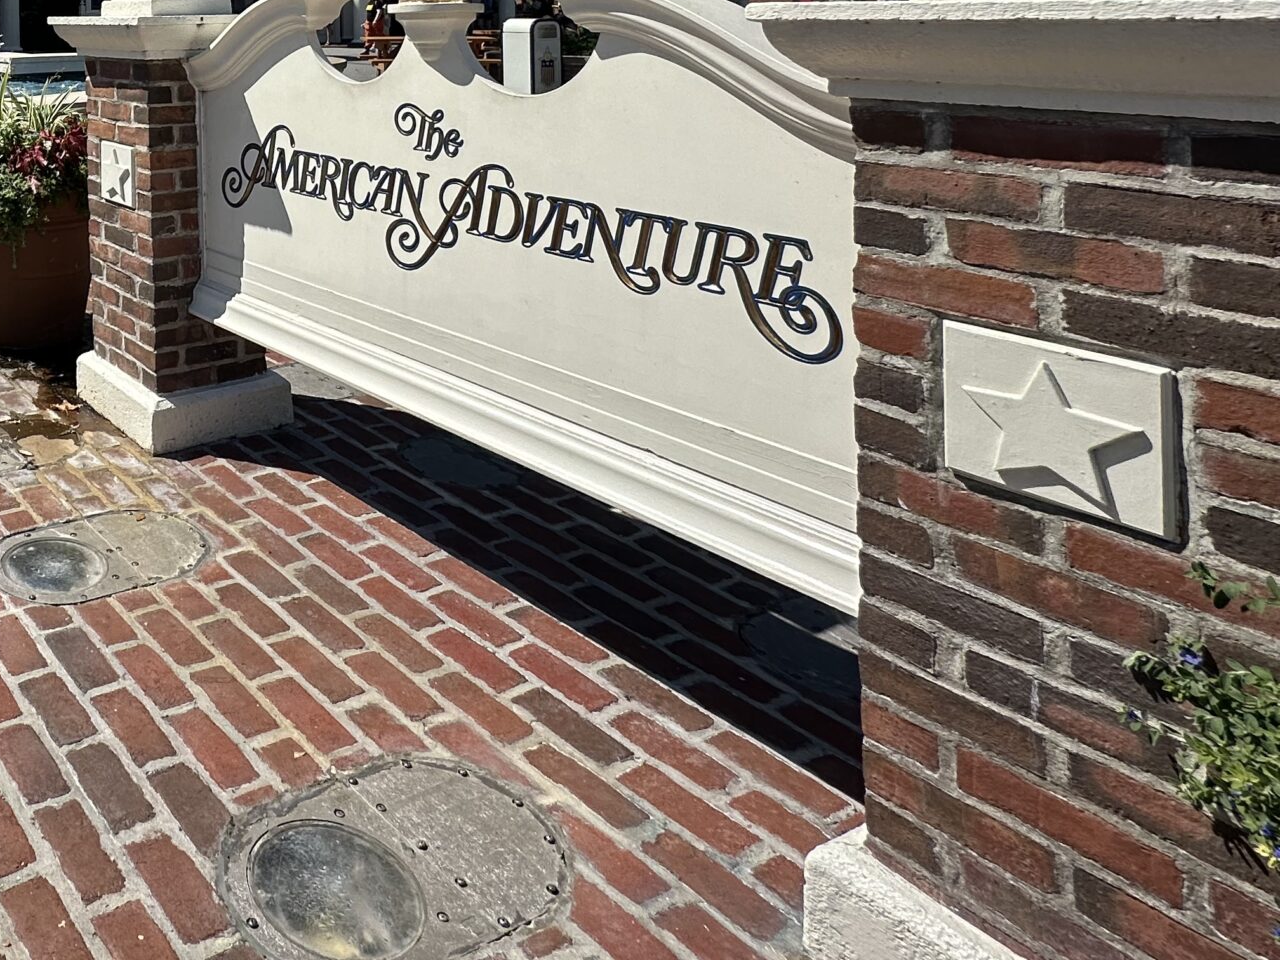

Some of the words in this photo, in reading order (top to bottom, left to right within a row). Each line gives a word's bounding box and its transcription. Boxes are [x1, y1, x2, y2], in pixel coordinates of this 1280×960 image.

[393, 102, 465, 162] The
[221, 124, 459, 249] AMERICAN
[385, 163, 844, 365] ADVENTURE
